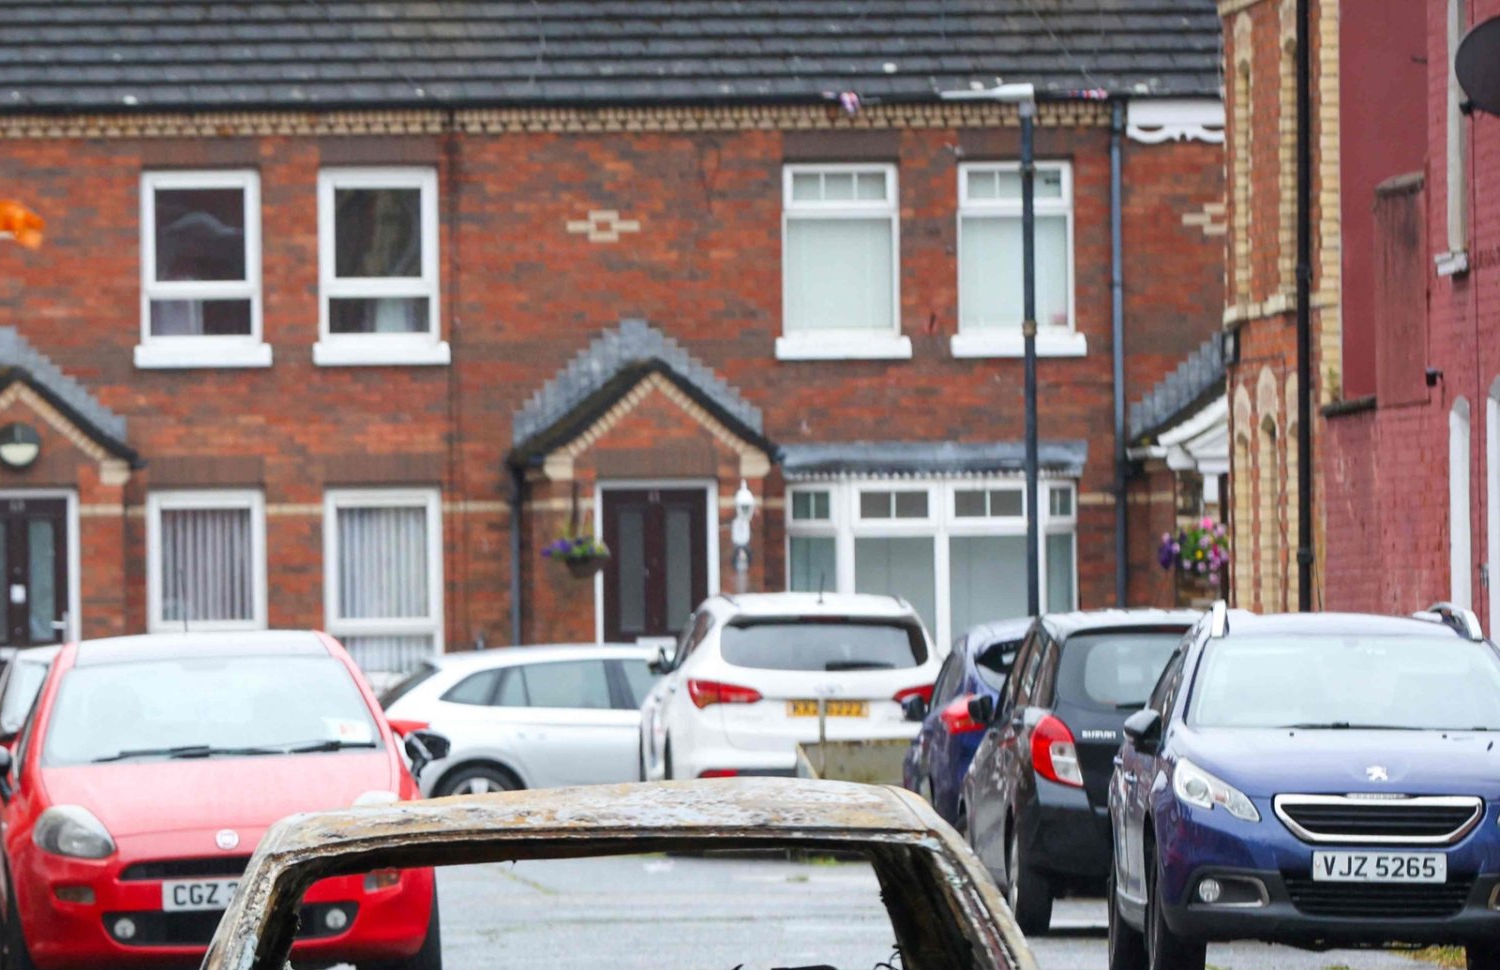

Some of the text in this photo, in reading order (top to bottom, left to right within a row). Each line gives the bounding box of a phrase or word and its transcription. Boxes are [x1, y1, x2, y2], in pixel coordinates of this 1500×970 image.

[1323, 856, 1436, 878] VJZ 5265
[172, 882, 219, 906] CGZ
